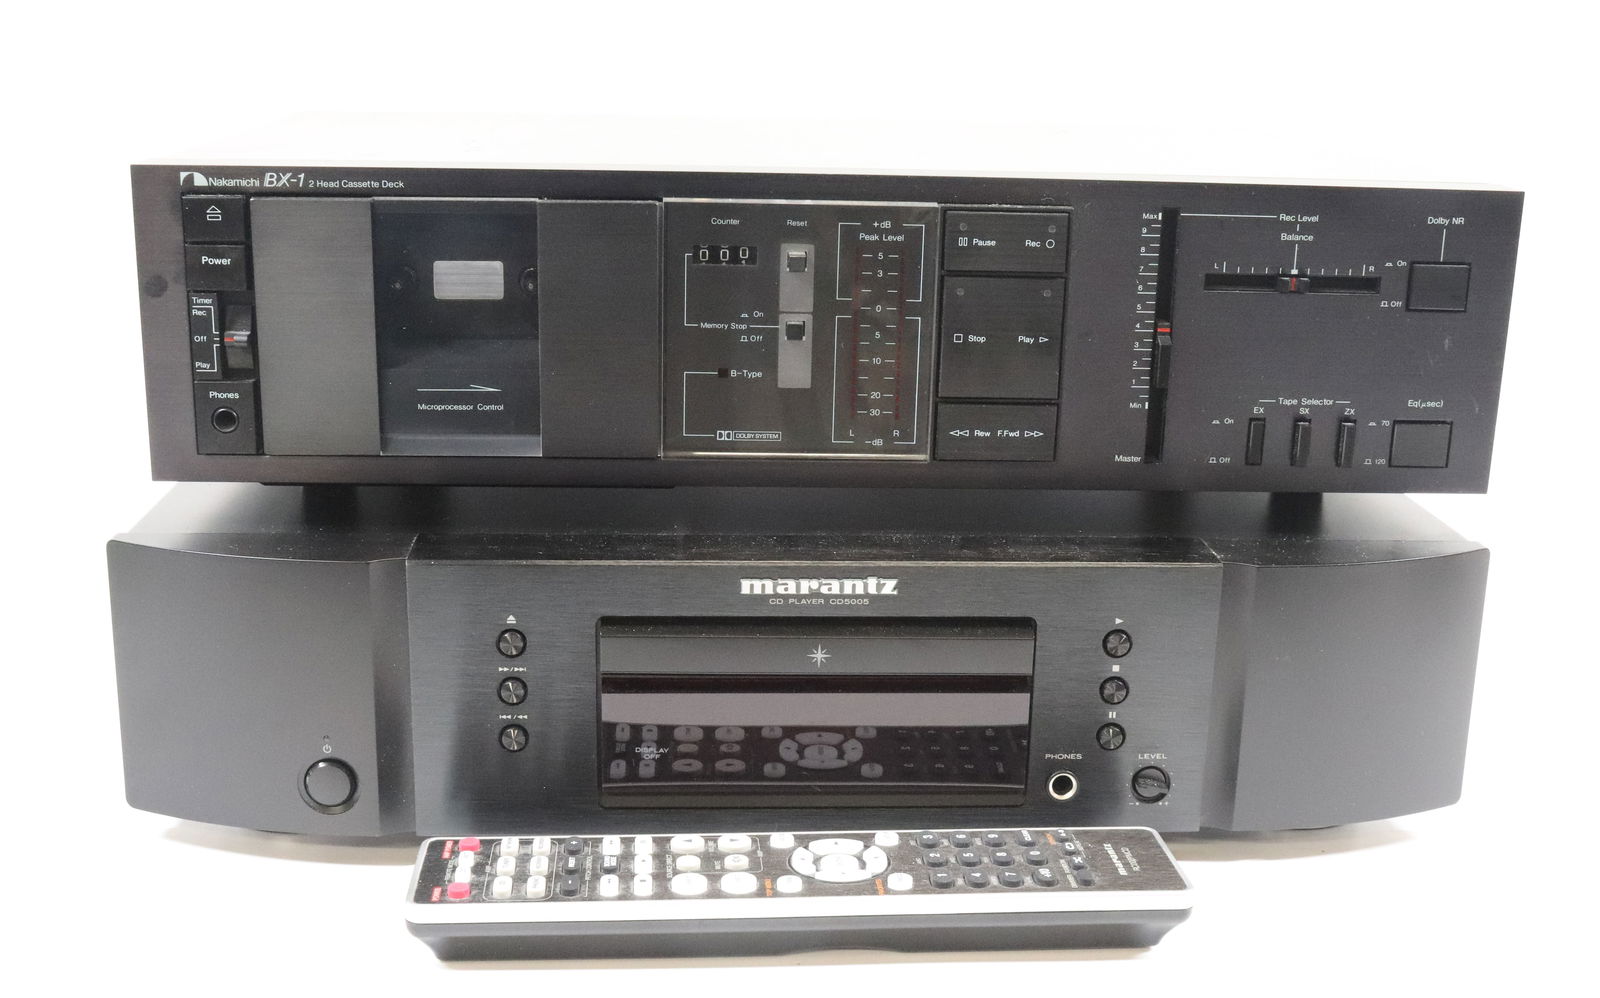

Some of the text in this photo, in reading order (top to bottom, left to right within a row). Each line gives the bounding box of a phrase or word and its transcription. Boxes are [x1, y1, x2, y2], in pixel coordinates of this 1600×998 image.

[208, 176, 260, 187] Nakamichi
[264, 172, 305, 188] BX-1
[317, 180, 339, 188] Head
[341, 180, 379, 188] Cassette
[382, 180, 404, 188] Deck
[711, 217, 740, 225] Counter
[786, 219, 808, 227] Reset
[1298, 215, 1319, 223] Level
[1428, 217, 1449, 226] Dolby
[859, 233, 905, 242] Peak Level
[1281, 233, 1313, 241] Balance
[972, 238, 996, 246] Pause
[878, 252, 884, 260] 5
[201, 256, 232, 265] Power
[877, 269, 883, 277] 3
[700, 322, 748, 332] Memory Stop
[968, 335, 986, 343] Stop
[1018, 336, 1035, 345] Play
[872, 357, 881, 365] 10
[195, 362, 211, 370] Play
[730, 370, 763, 378] B-Type
[209, 391, 240, 399] Phones
[1278, 398, 1334, 406] Tape Selector
[417, 403, 504, 411] Microprocessor Control
[849, 429, 855, 437] L
[1115, 455, 1141, 463] Master
[740, 577, 899, 595] marantz
